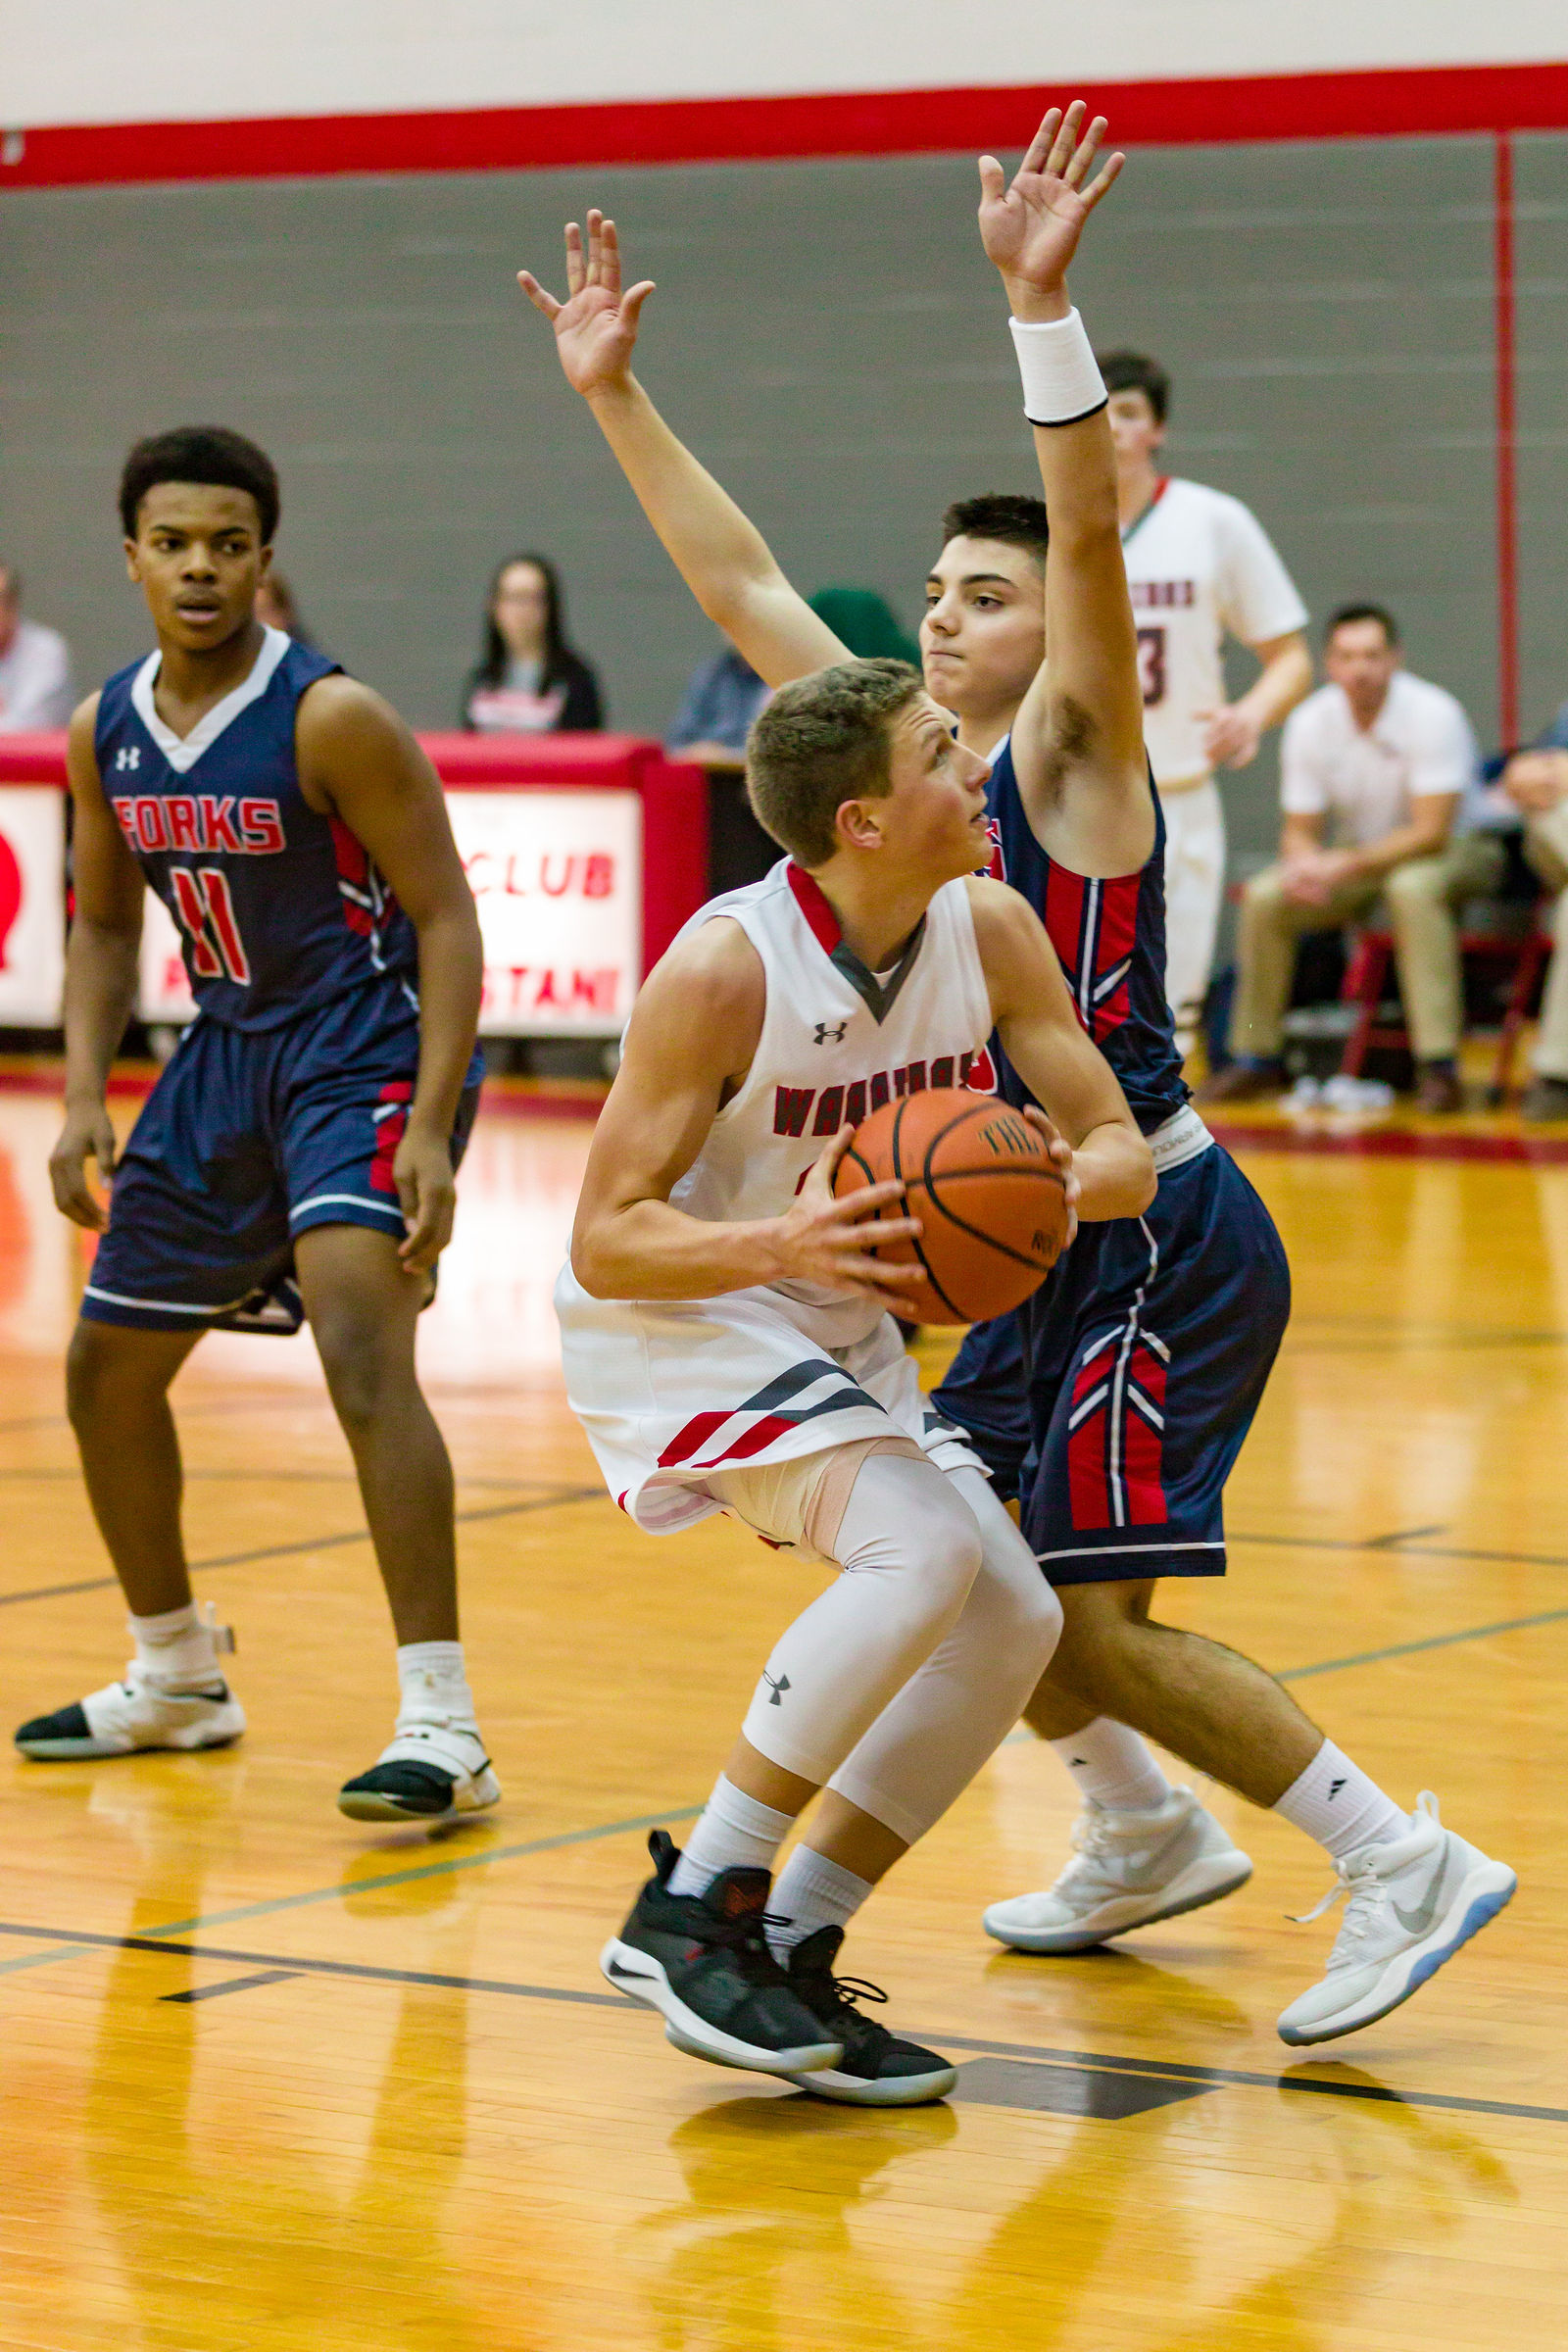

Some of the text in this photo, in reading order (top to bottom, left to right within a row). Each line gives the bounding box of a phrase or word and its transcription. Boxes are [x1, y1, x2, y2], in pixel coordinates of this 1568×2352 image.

[112, 796, 287, 854] FORKS
[466, 852, 615, 901] CLUB
[170, 866, 251, 987] 11
